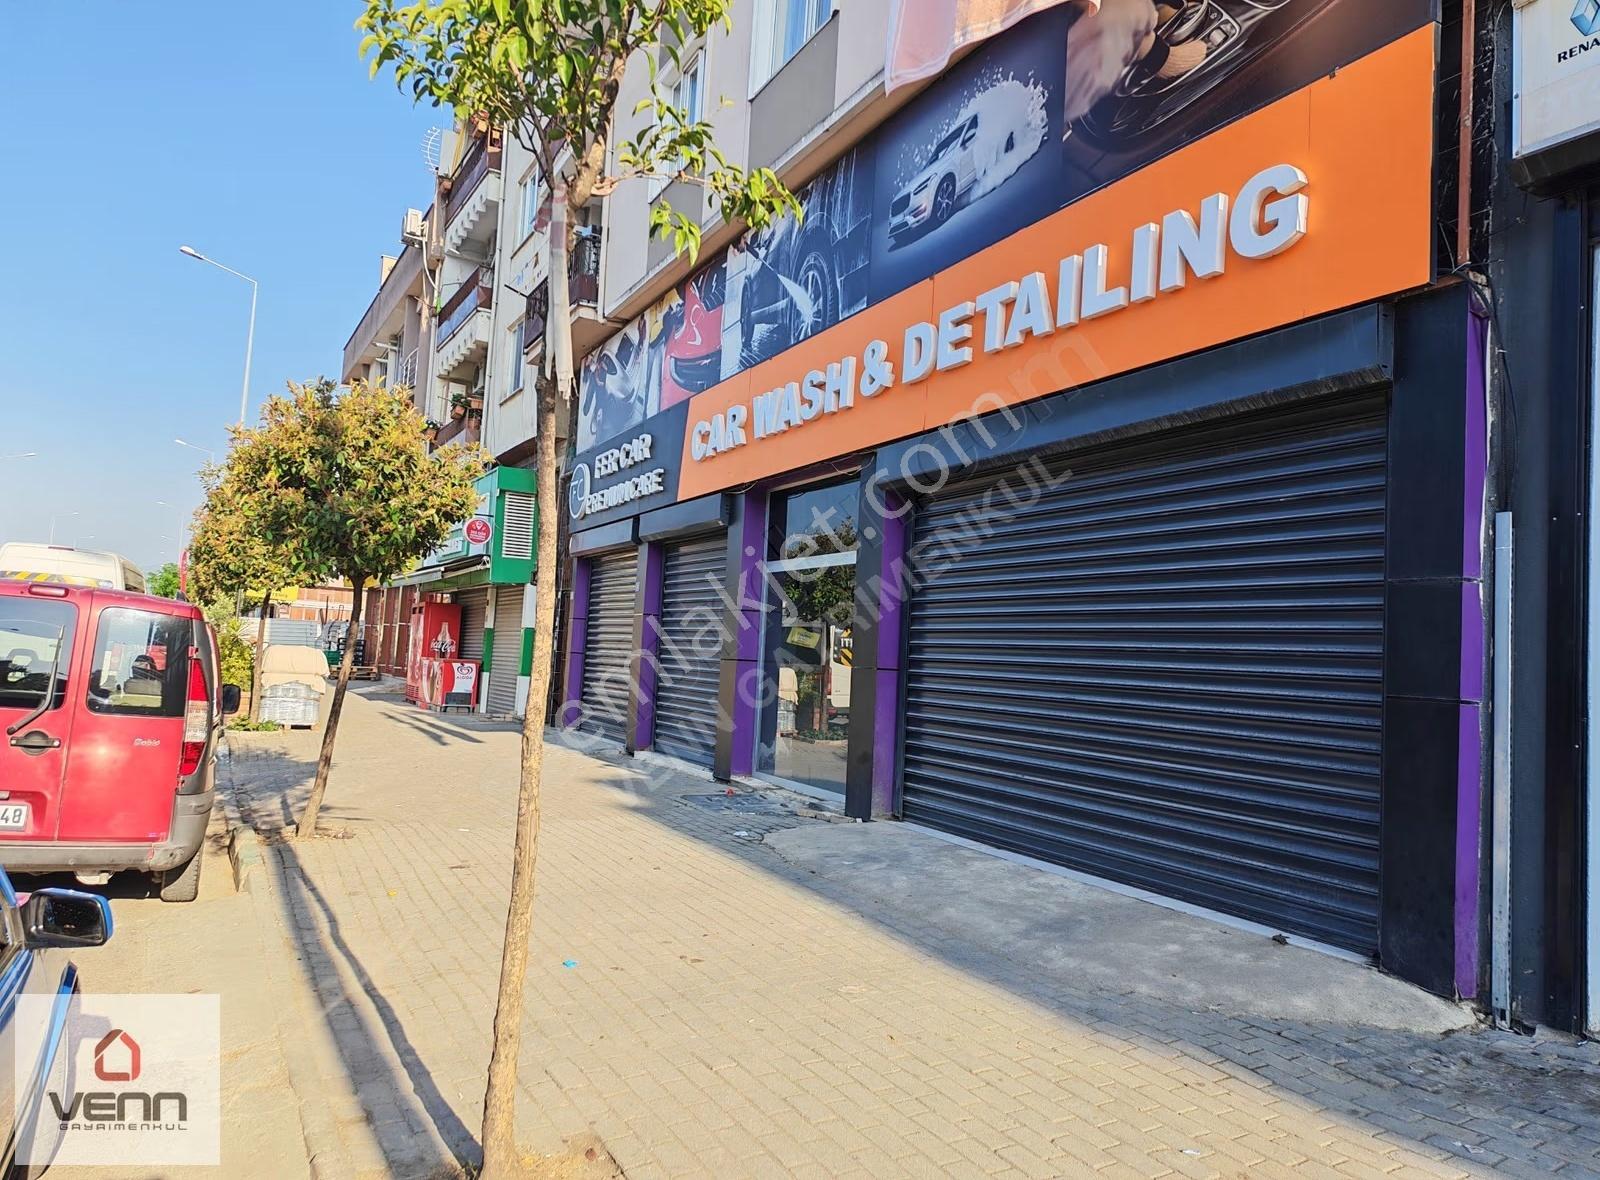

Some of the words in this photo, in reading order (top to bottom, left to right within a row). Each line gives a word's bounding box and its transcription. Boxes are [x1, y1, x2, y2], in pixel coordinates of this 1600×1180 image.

[691, 404, 747, 462] CAR
[753, 356, 856, 440] WASH
[860, 340, 895, 398] &
[902, 164, 1309, 385] DETAILING
[594, 448, 620, 479] FER
[619, 433, 652, 469] CAR
[0, 807, 23, 824] 48
